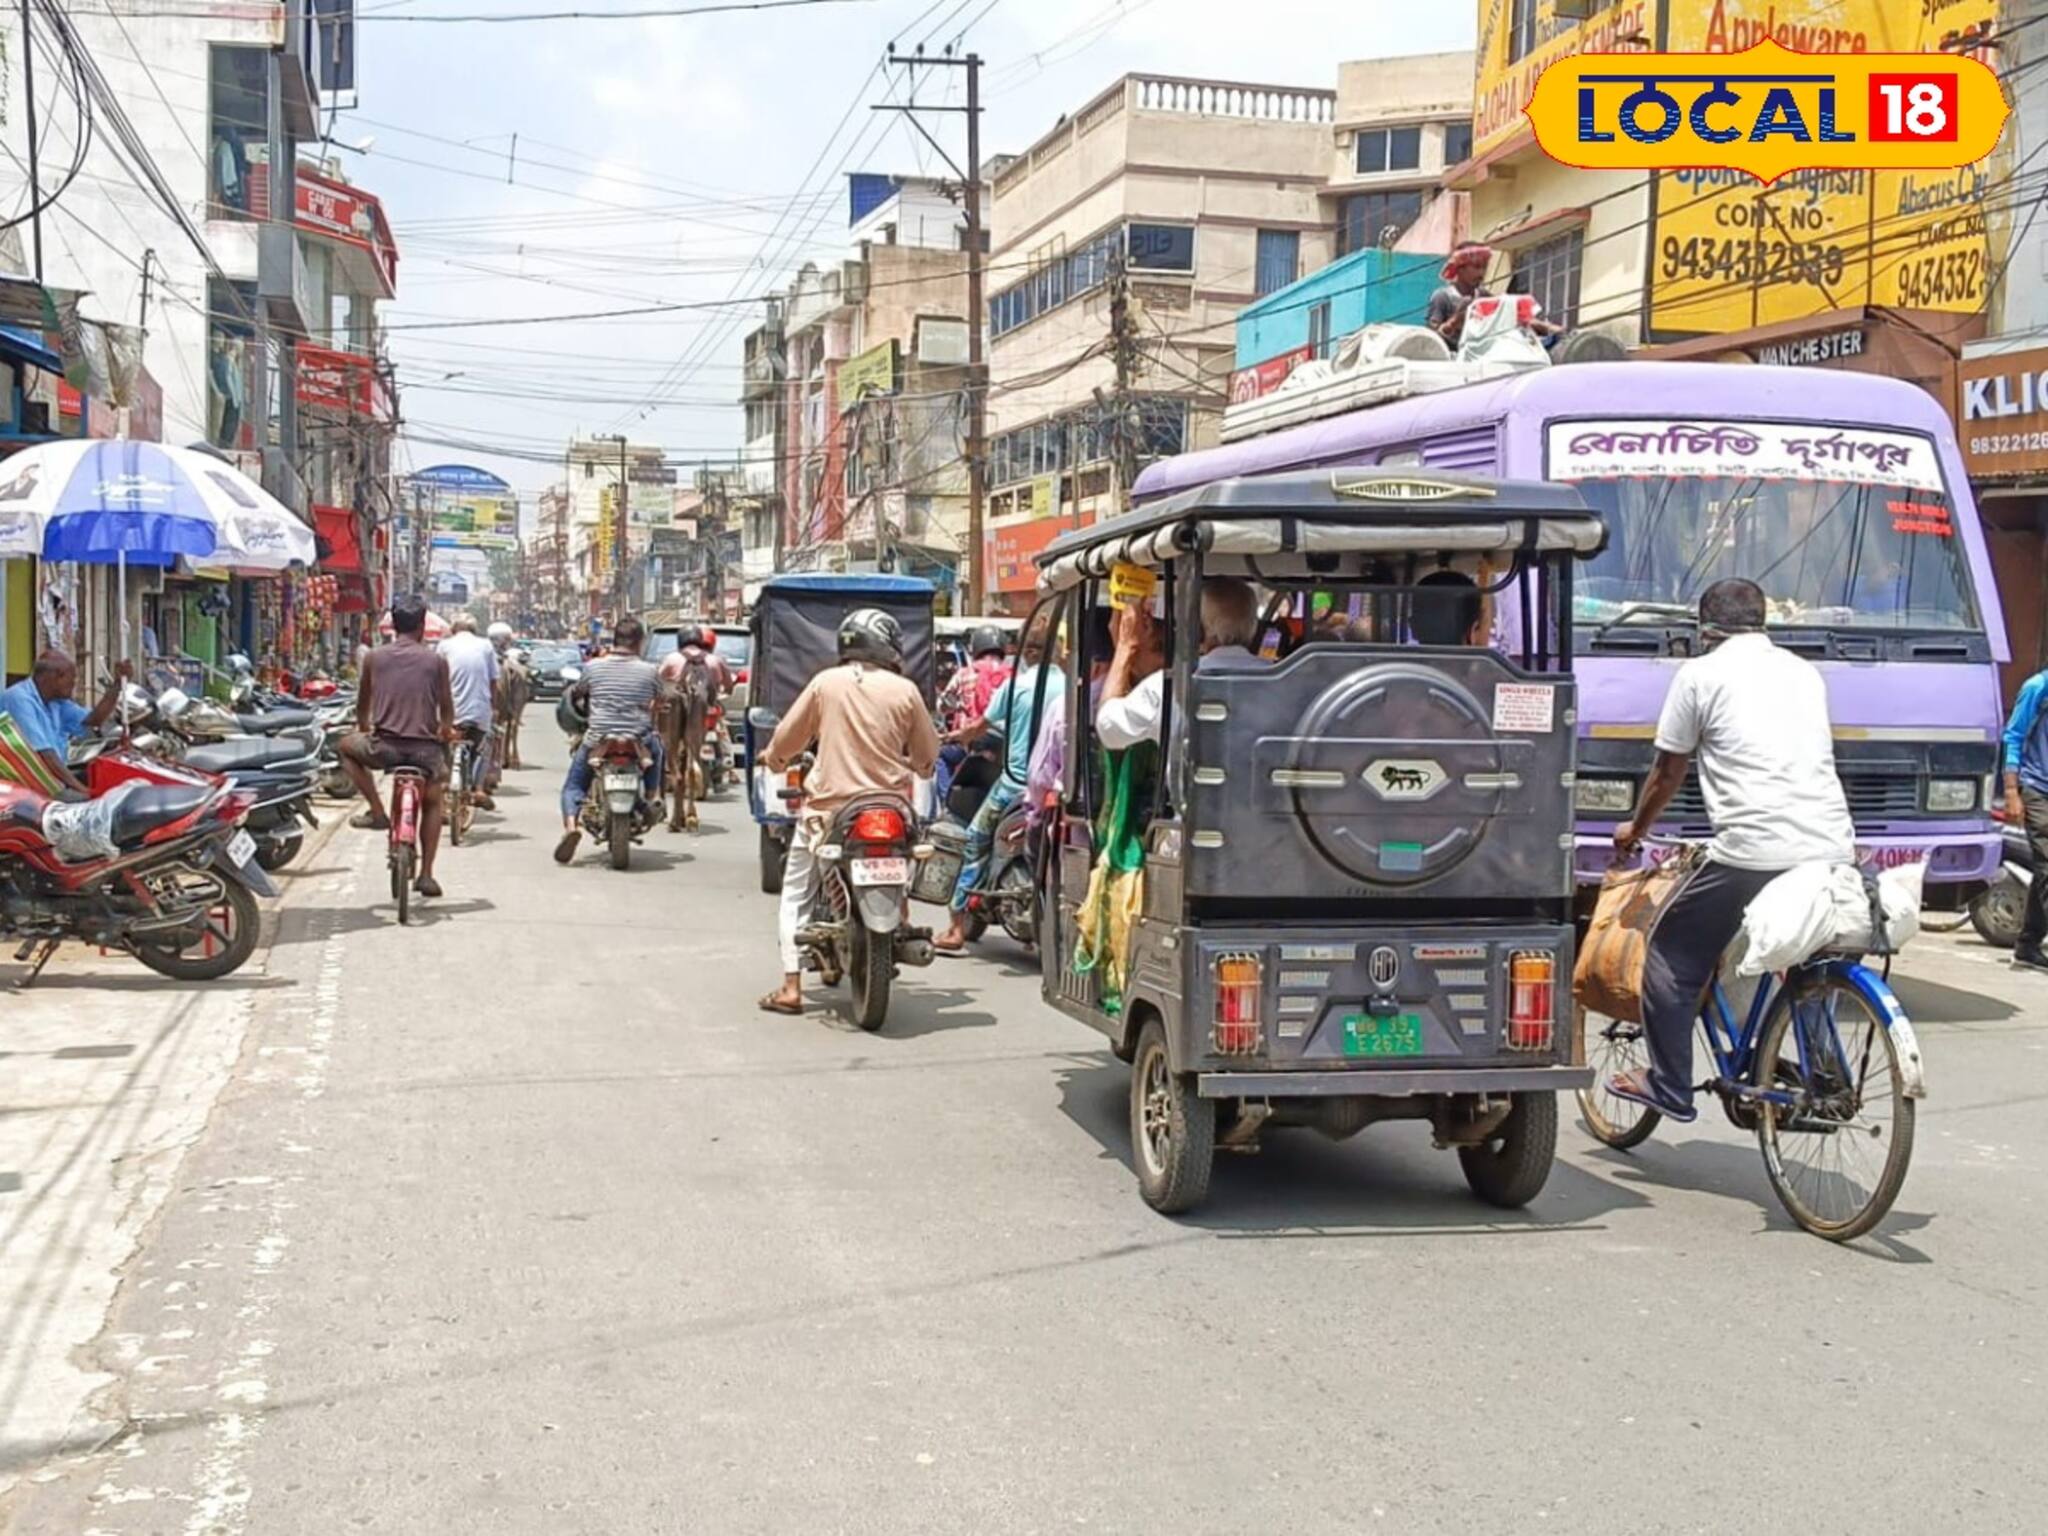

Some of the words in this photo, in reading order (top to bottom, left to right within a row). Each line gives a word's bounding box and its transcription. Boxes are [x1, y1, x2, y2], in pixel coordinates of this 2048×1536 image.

[1759, 329, 1863, 366] MANCHESTER
[1569, 424, 1763, 456] বেনাচিতি
[1781, 432, 1912, 473] দুর্গাপুর
